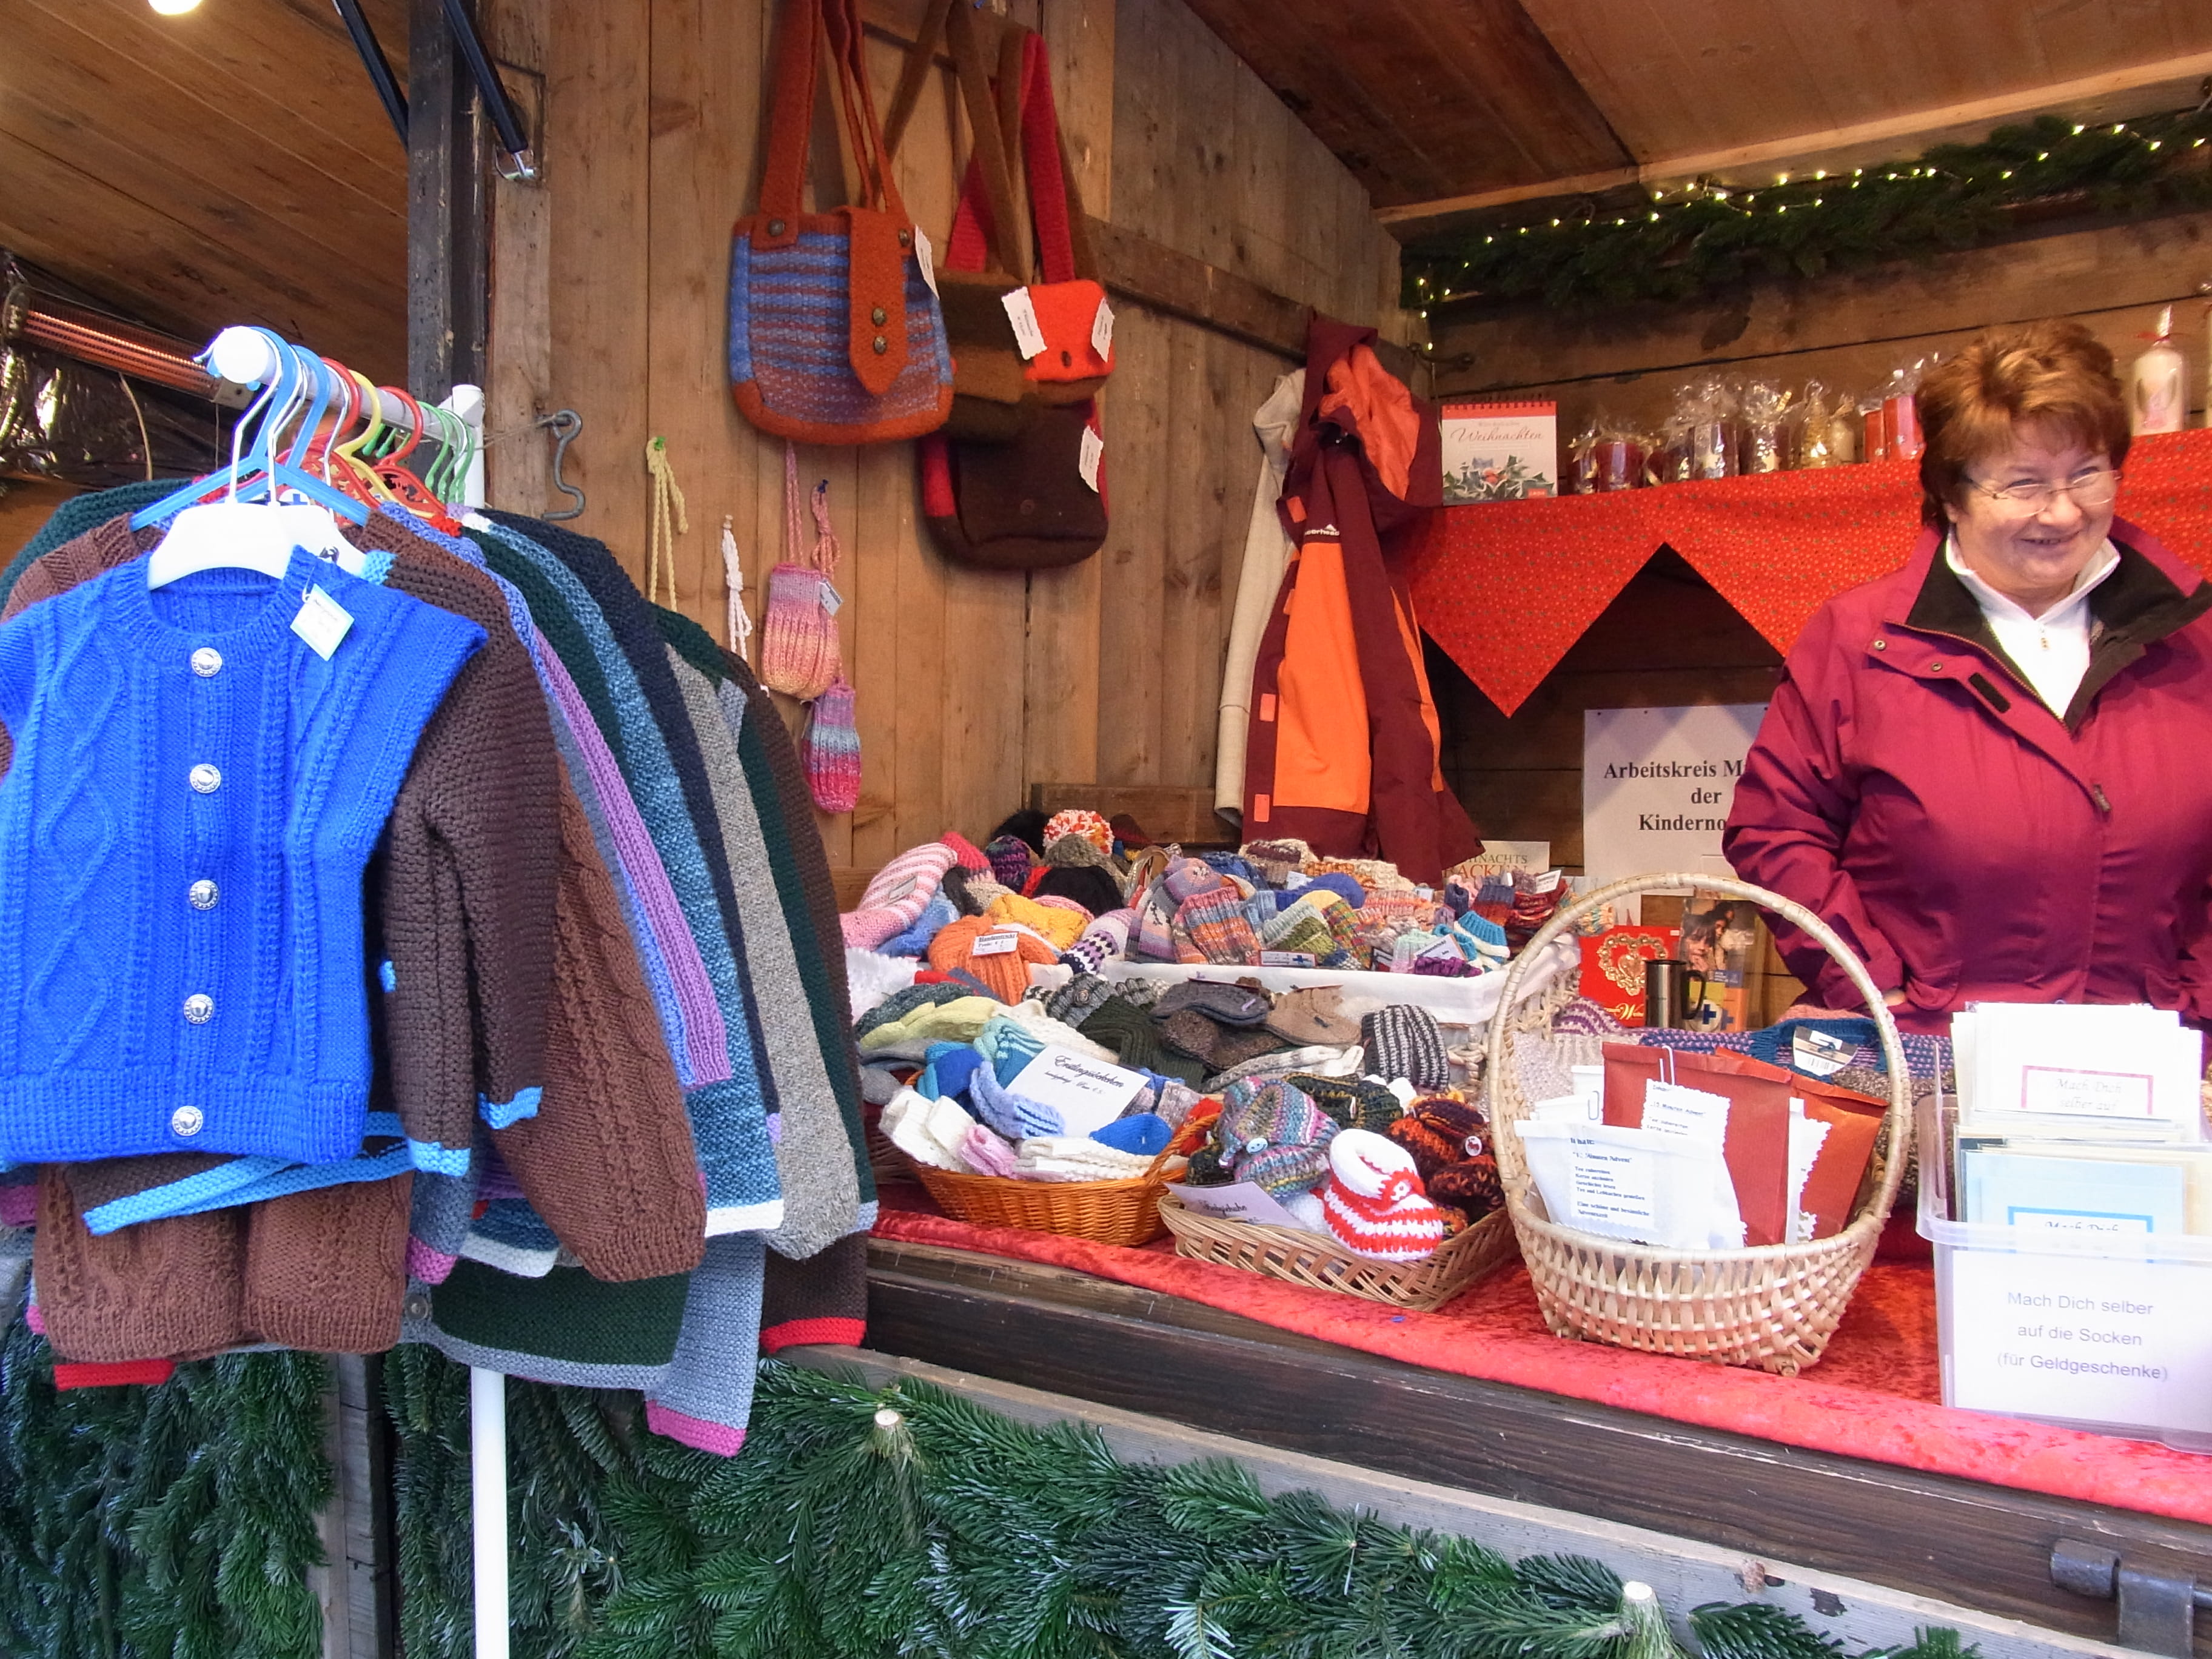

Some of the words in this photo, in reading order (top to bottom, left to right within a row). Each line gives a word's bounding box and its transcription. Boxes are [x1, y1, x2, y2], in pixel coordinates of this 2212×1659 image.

[1450, 426, 1543, 442] Weihnachten
[1604, 760, 1717, 779] Arbeitskreis
[1723, 759, 1744, 777] M
[1691, 787, 1722, 804] der
[1639, 814, 1726, 831] Kinderno
[2056, 1078, 2090, 1091] Mach
[2095, 1081, 2122, 1094] Dich
[2007, 1292, 2052, 1307] Mach
[2058, 1295, 2095, 1310] Dich
[2101, 1301, 2154, 1315] selber
[2017, 1325, 2044, 1338] auf
[2048, 1327, 2073, 1340] die
[2079, 1329, 2142, 1346] Socken
[1997, 1352, 2025, 1368] (für
[2030, 1355, 2168, 1382] Geldgeschenke)
